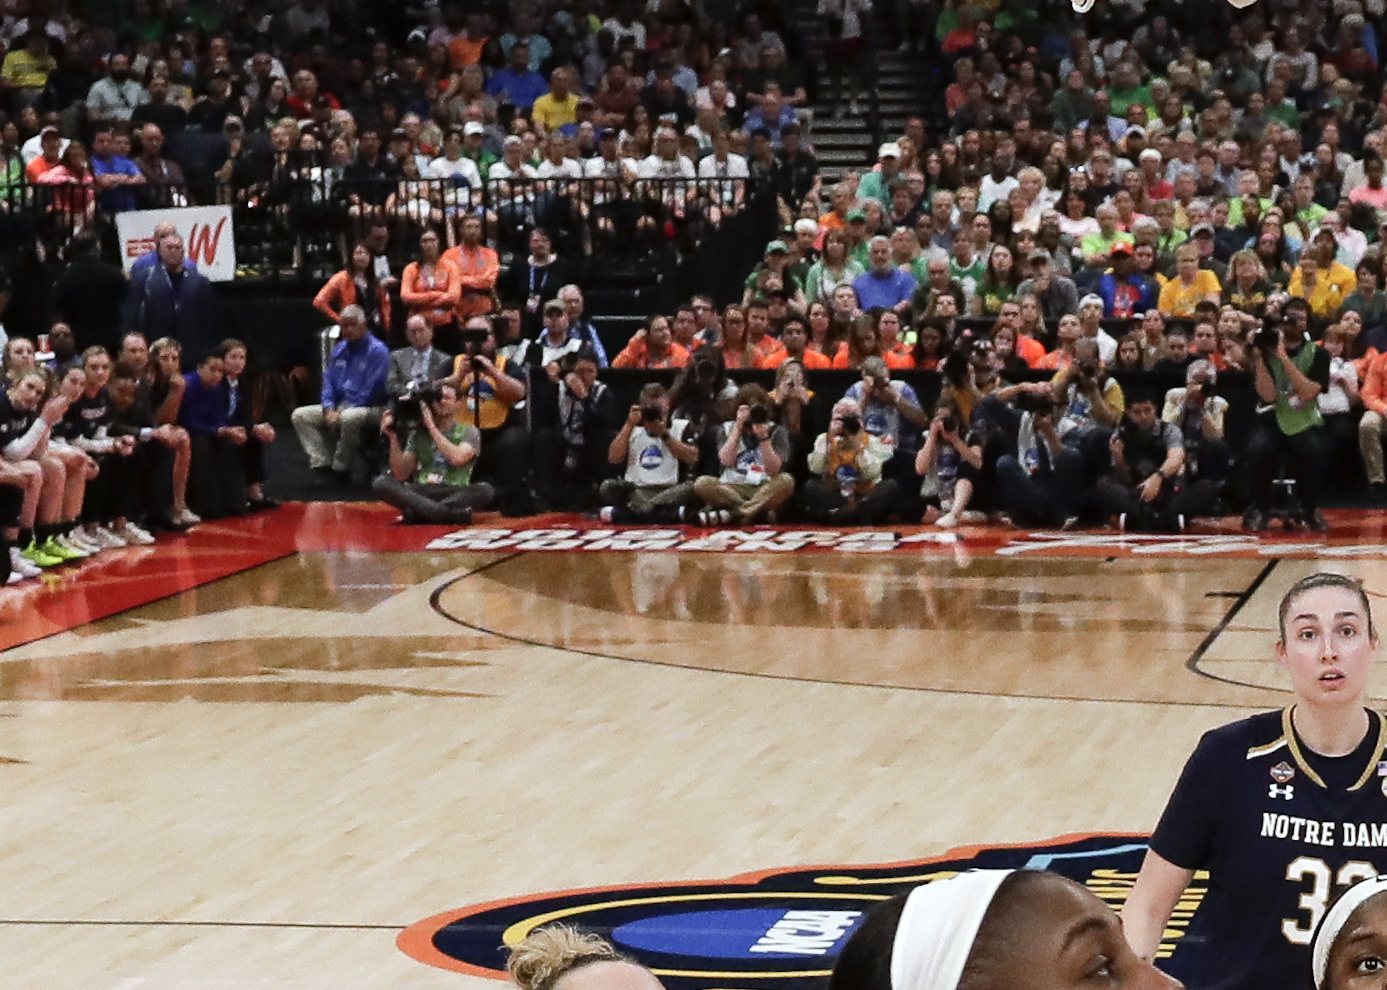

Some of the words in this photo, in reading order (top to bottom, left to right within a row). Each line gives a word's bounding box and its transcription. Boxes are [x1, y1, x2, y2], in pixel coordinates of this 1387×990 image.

[1260, 812, 1336, 846] NOTRE
[1281, 856, 1380, 946] 3
[749, 909, 863, 955] NCAA
